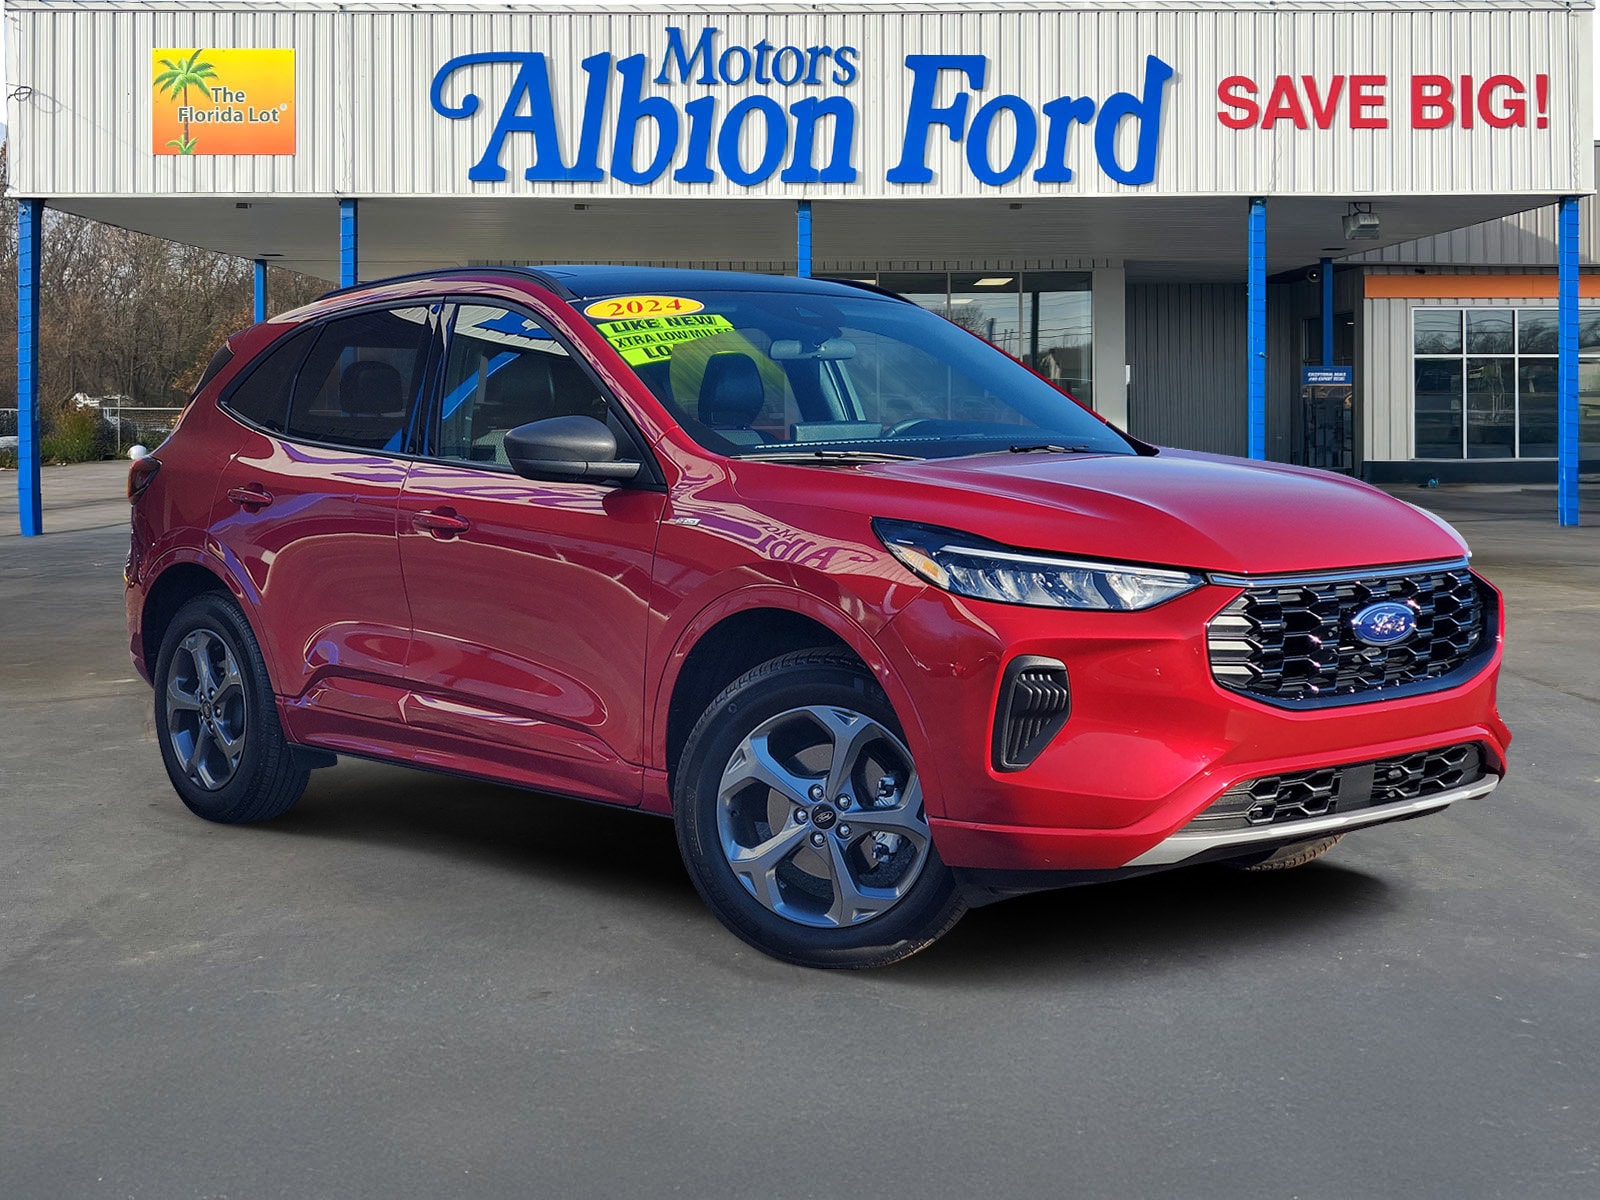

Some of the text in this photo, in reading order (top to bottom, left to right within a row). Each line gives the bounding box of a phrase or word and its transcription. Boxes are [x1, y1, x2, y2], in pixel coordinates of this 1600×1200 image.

[653, 27, 858, 86] Motors
[210, 86, 246, 103] The
[1217, 74, 1549, 130] SAVE BIG!
[177, 106, 244, 123] Florida
[430, 51, 1174, 186] Albion Ford
[607, 299, 682, 317] 2024
[610, 315, 715, 334] LIKE NEW
[614, 333, 656, 348] XTRA
[656, 330, 688, 341] LOW
